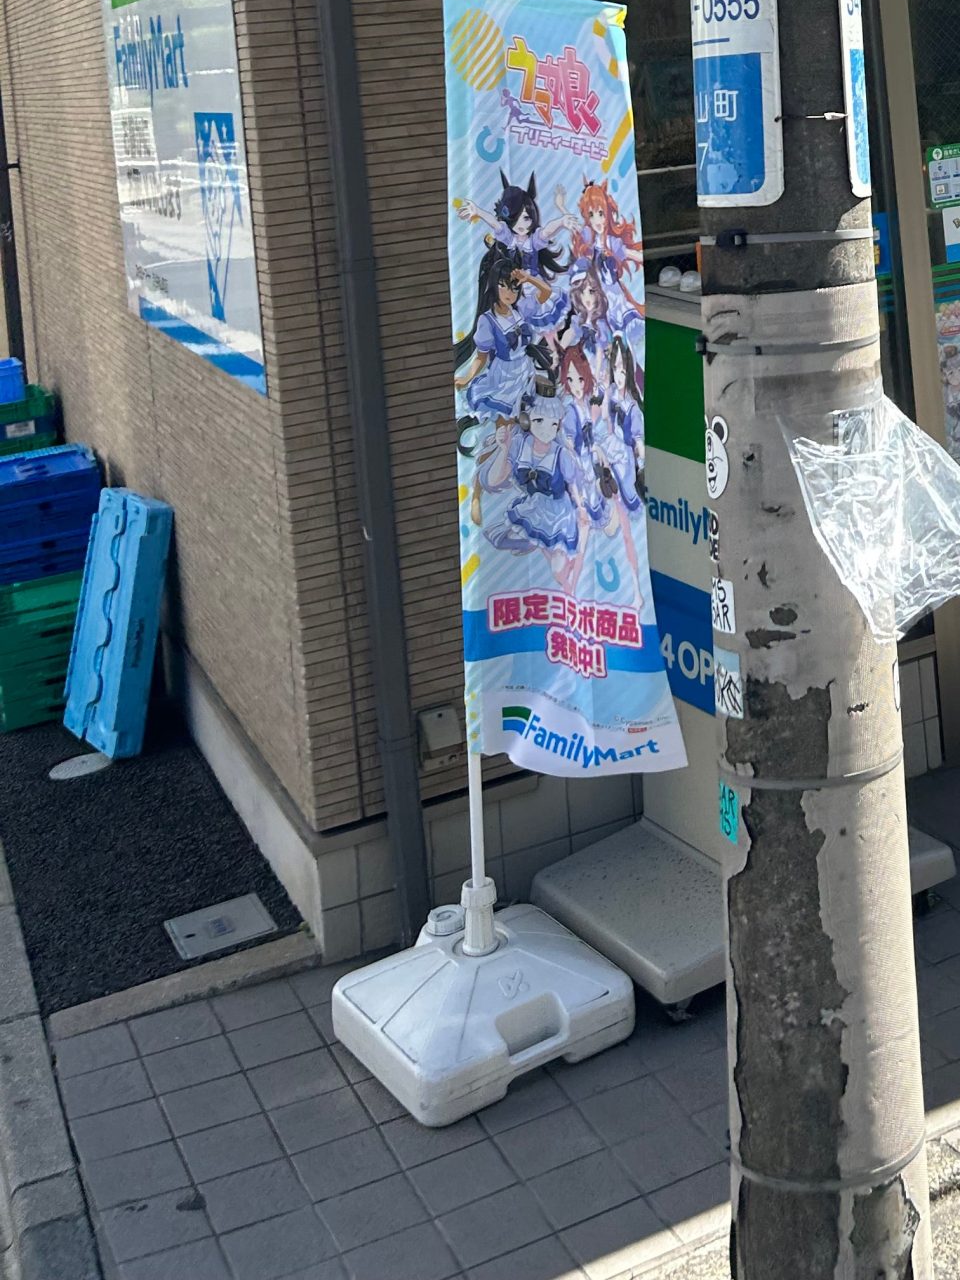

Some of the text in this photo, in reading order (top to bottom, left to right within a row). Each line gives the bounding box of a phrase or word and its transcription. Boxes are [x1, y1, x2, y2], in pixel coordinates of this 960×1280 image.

[113, 14, 188, 110] FamilyMart
[493, 594, 640, 644] 限定コラボ商品
[551, 630, 603, 674] 発売中!
[525, 713, 660, 769] FamilyMart
